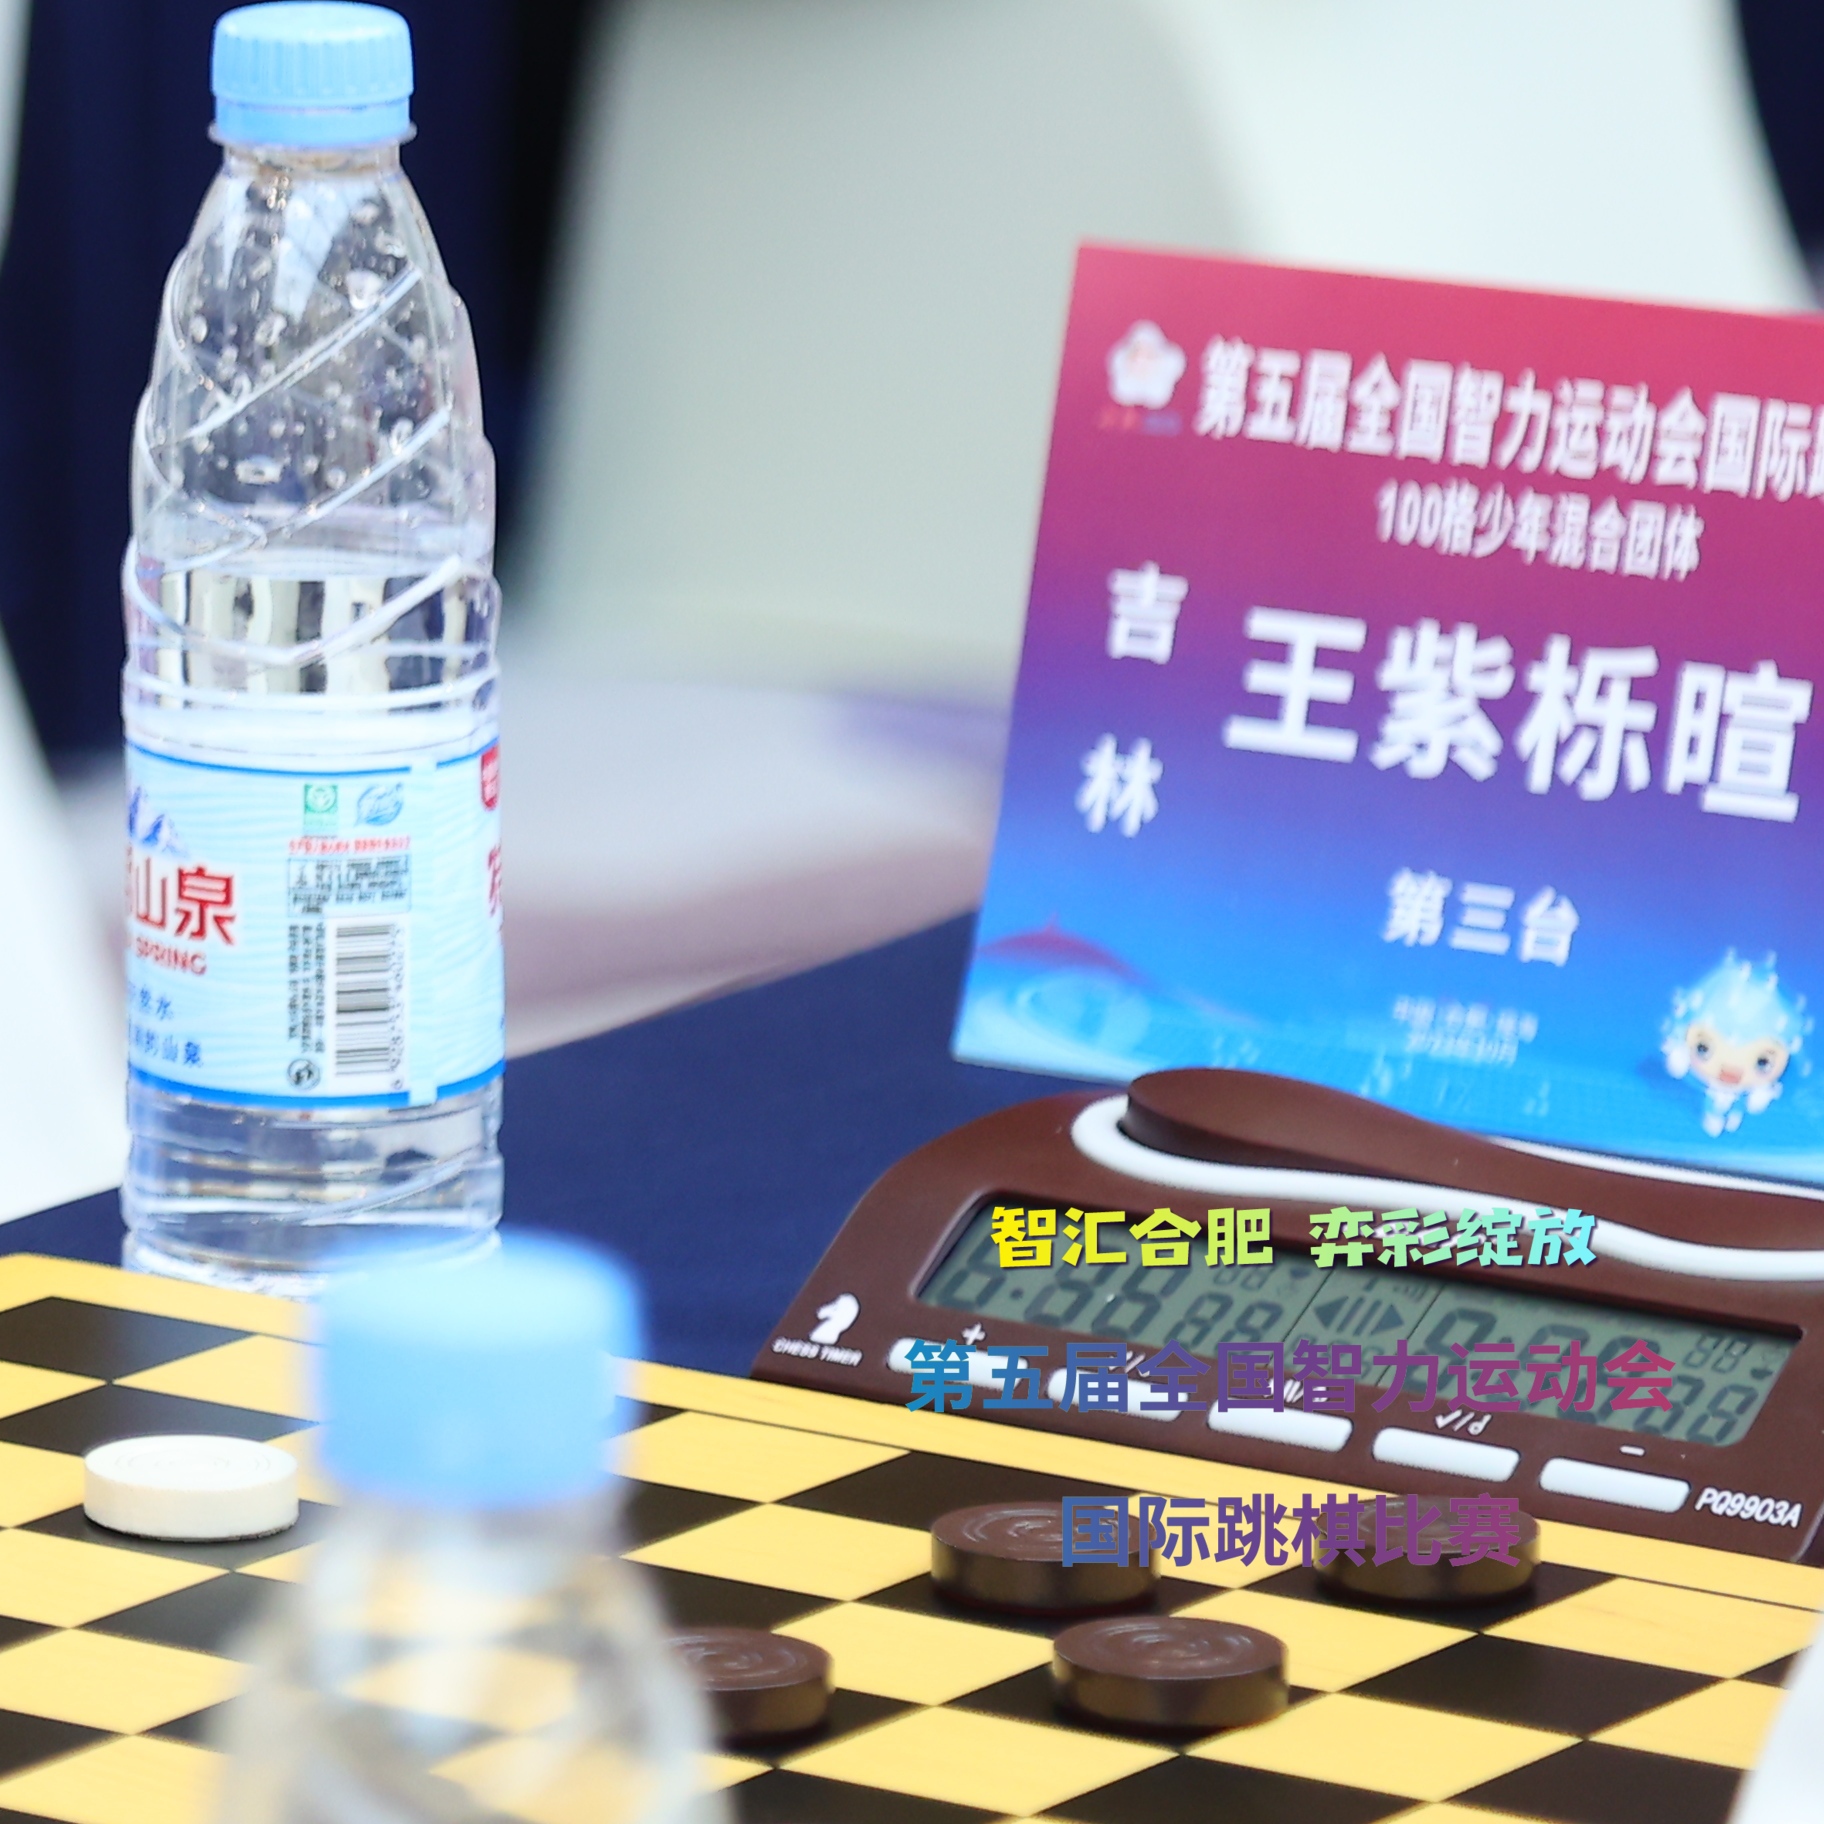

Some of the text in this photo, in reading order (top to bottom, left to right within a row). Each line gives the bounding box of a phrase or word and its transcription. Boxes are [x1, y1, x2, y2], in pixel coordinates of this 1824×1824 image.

[1376, 479, 1704, 582] 100格少年混合团体
[1222, 606, 1814, 823] 王紫栎暄
[126, 844, 236, 946] 山泉
[1383, 869, 1580, 968] 第三台
[1694, 1485, 1804, 1529] PQ9903A
